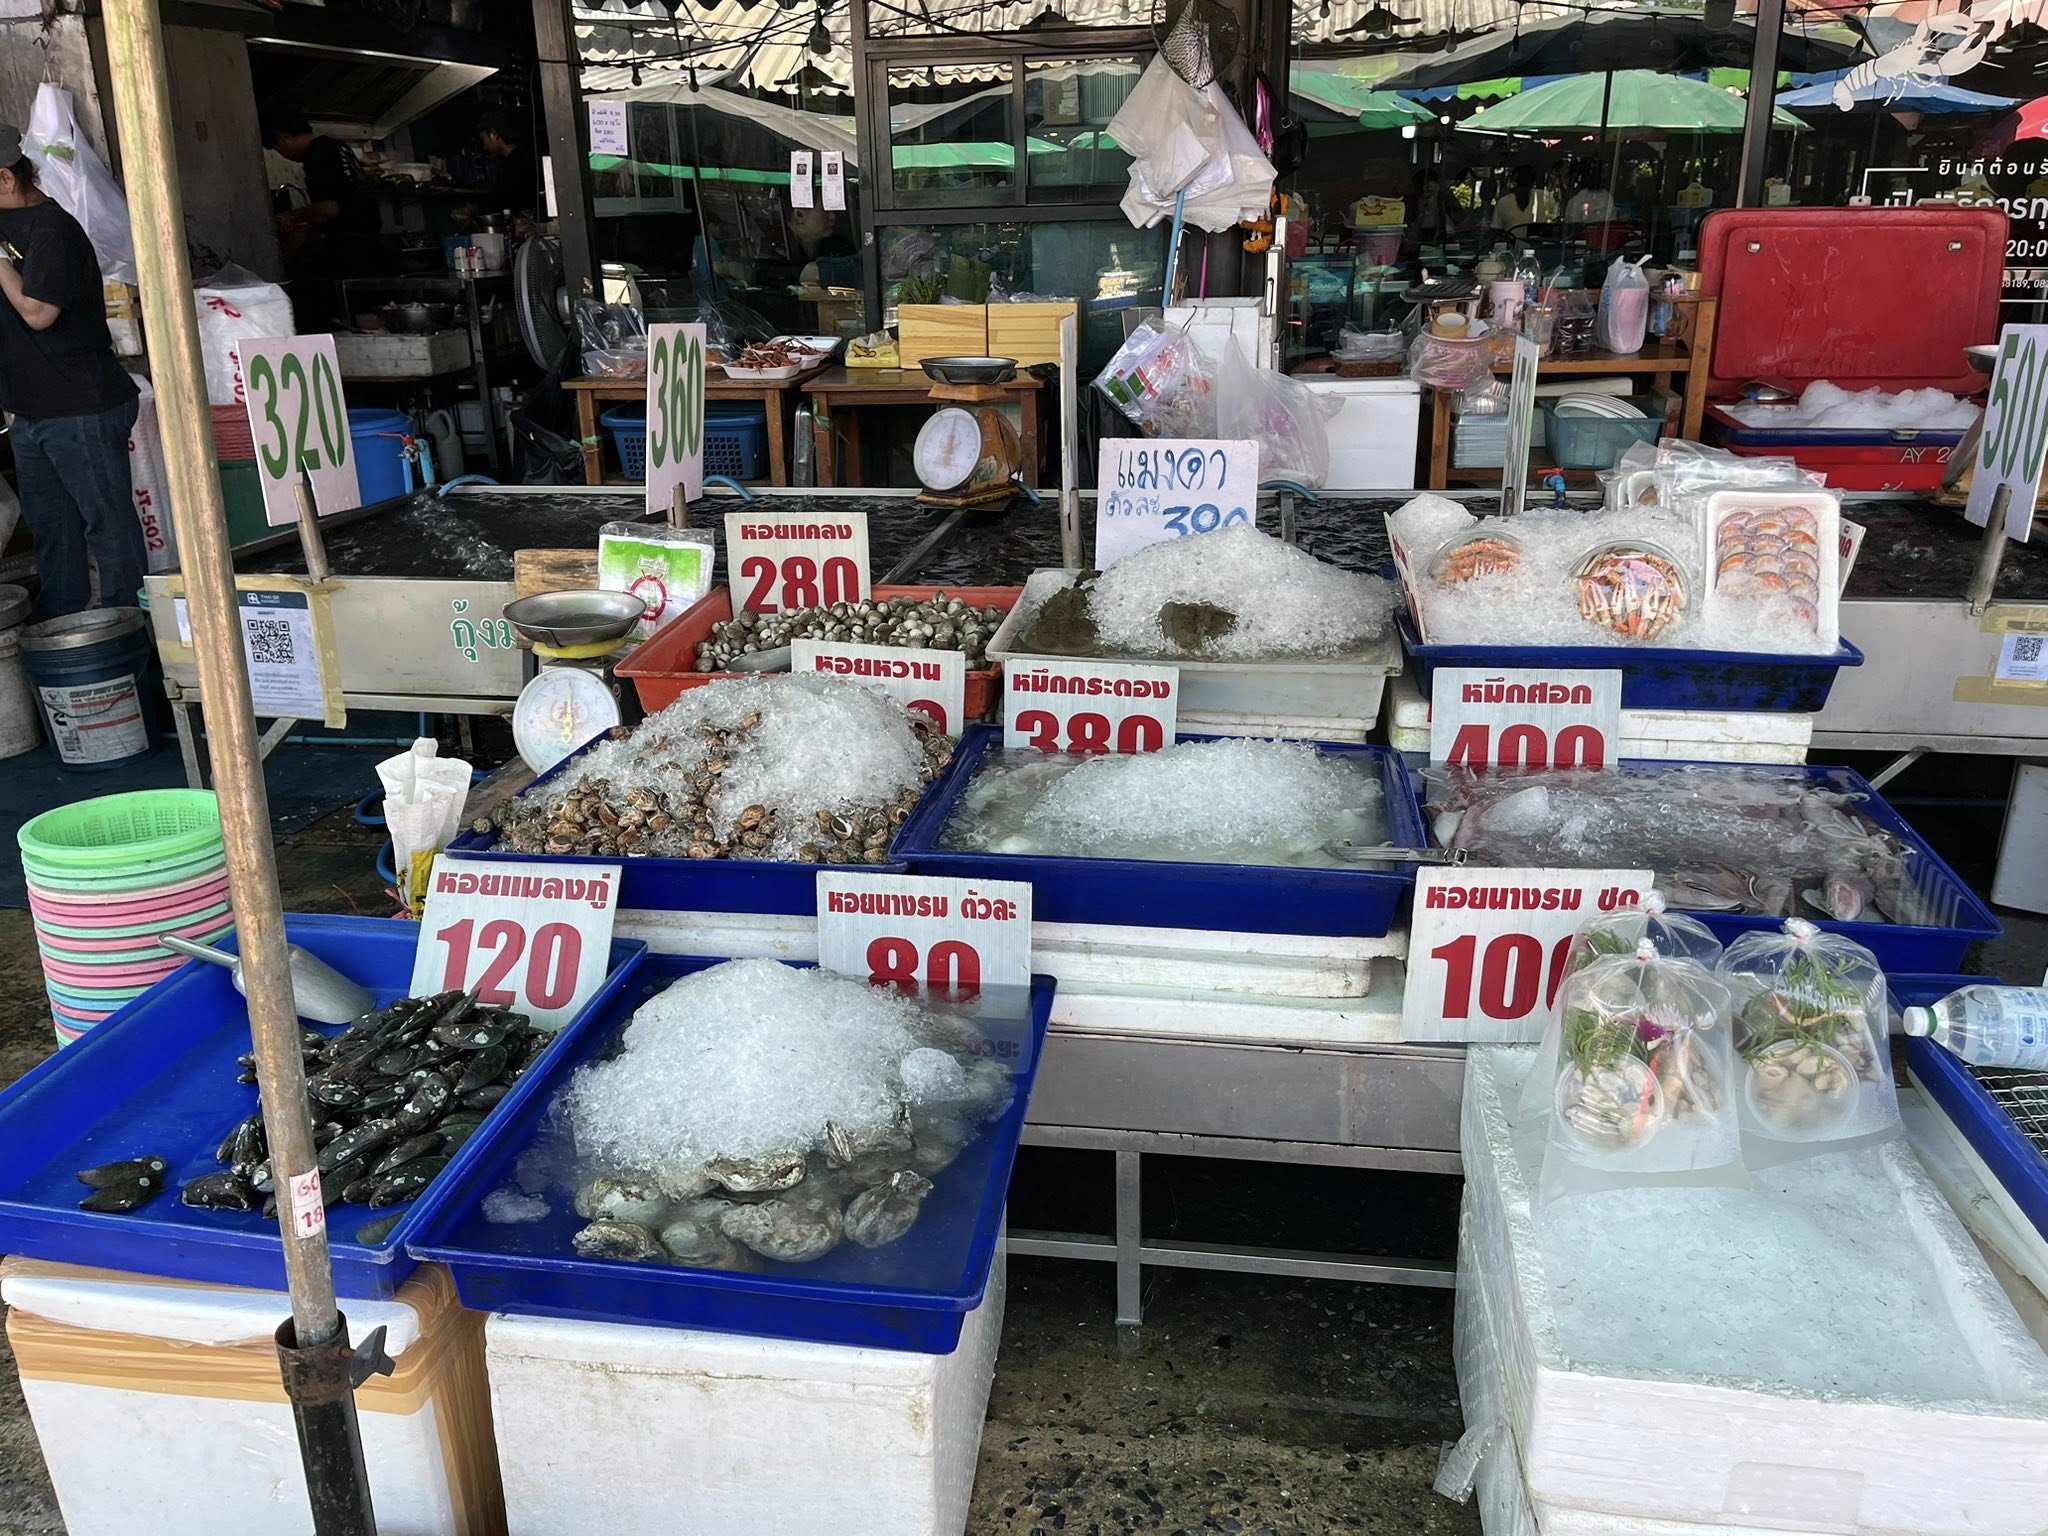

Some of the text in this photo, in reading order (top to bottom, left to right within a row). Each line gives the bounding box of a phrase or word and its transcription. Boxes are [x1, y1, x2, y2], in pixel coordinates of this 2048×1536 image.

[250, 352, 345, 480] 320
[651, 329, 700, 469] 360
[1983, 333, 2048, 485] 500
[1900, 447, 1955, 464] AY 2
[134, 488, 166, 552] JT-502
[741, 524, 852, 540] หอยแคลง
[740, 556, 860, 614] 280
[451, 599, 517, 662] กุ้งม
[815, 655, 941, 681] หอยหวาน
[1012, 668, 1171, 699] หมึกกระดอง
[1462, 677, 1592, 704] หมึกศอก
[436, 871, 611, 909] หอยแมลงภู่
[828, 889, 1017, 921] หอยนางรม ตัวละ
[1425, 886, 1640, 911] หอยนางรม ชด
[436, 918, 582, 1010] 120
[301, 1205, 323, 1228] 18
